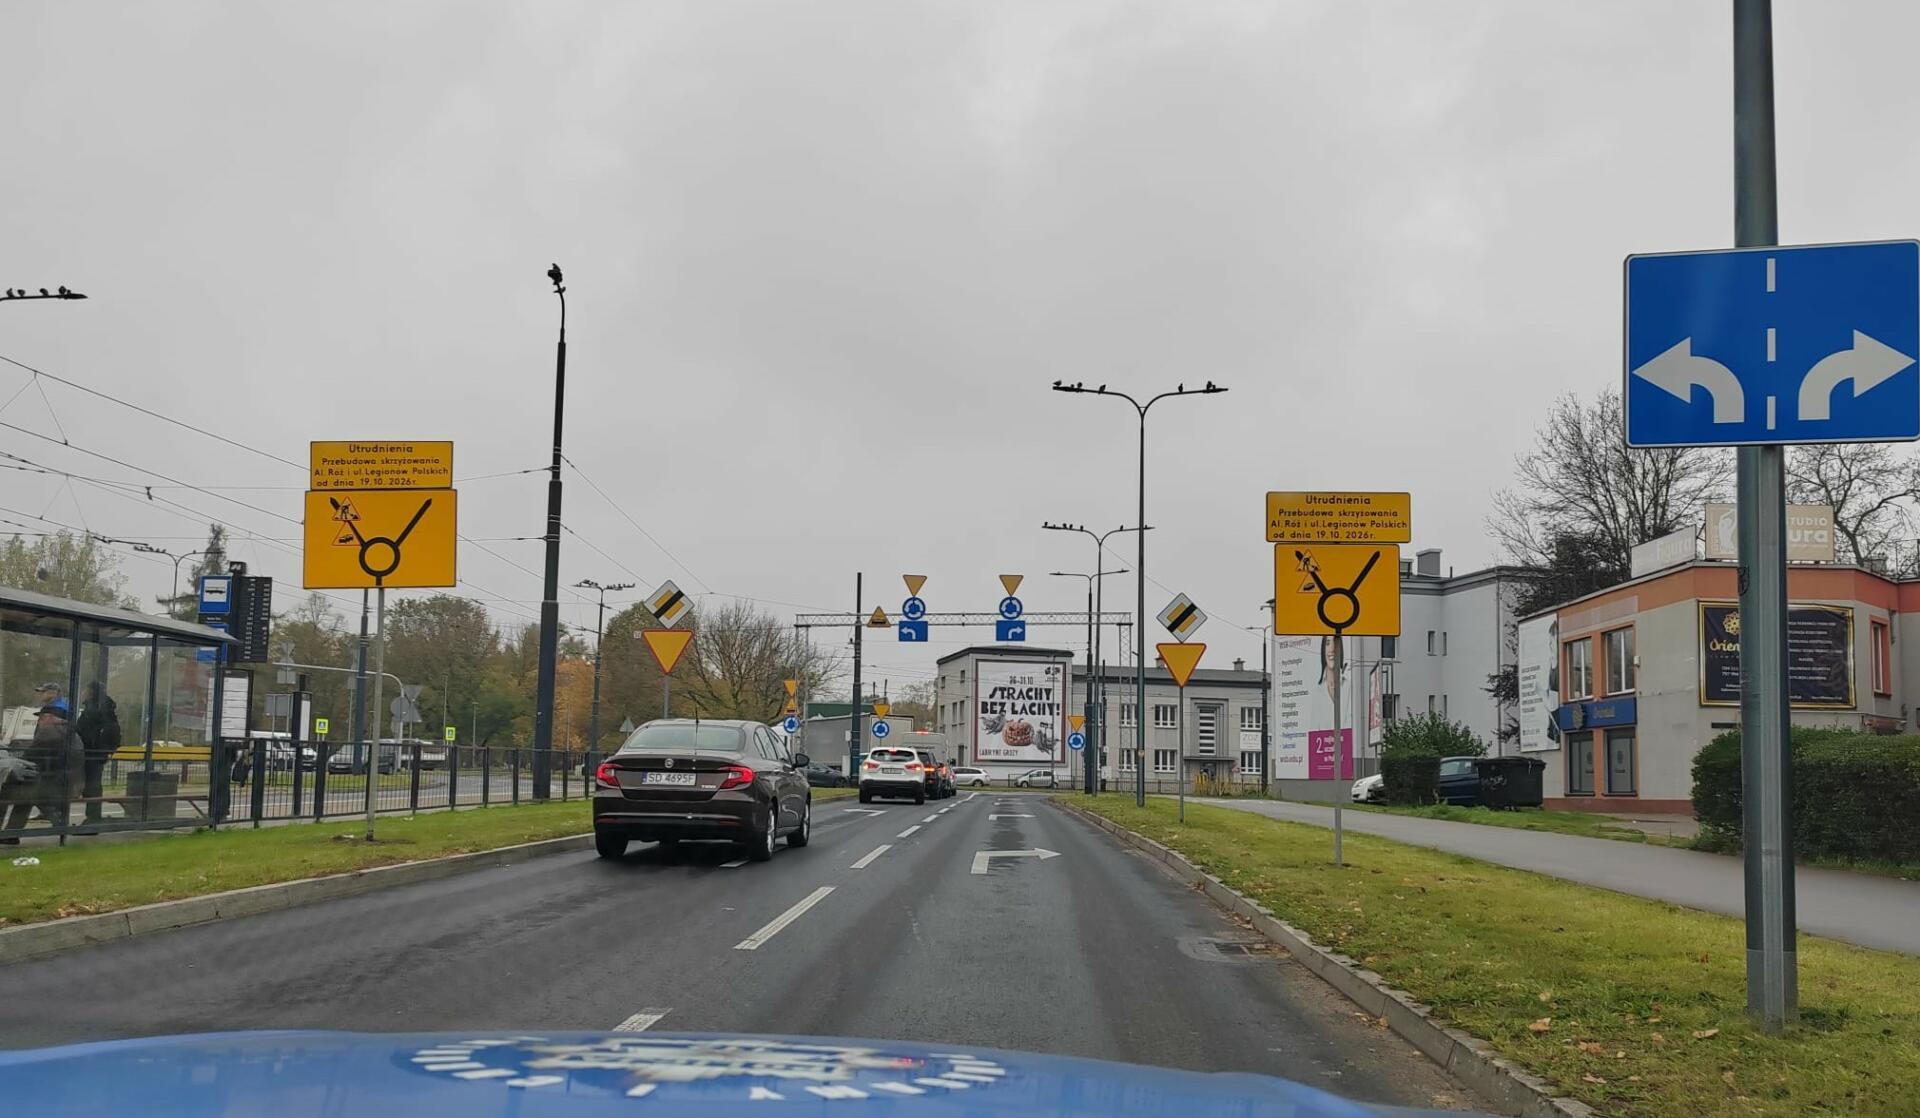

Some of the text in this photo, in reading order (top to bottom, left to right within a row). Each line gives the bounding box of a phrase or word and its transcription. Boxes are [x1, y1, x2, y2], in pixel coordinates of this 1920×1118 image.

[349, 444, 413, 453] Utrudnienia
[322, 457, 376, 465] Przebudowa
[412, 466, 449, 475] Polskich
[316, 479, 328, 487] od
[333, 479, 354, 487] dnia
[1305, 495, 1371, 505] Utrudnienia
[1279, 508, 1398, 519] Przebudowa skrzyżowania
[1370, 519, 1408, 528] Polskich
[1787, 516, 1828, 527] TUDIO
[1273, 530, 1285, 539] od
[1290, 530, 1311, 539] dnia
[1788, 529, 1828, 544] ura
[1709, 637, 1740, 651] Orien
[989, 687, 1053, 701] STRACHY
[981, 701, 1007, 715] BEZ
[1316, 737, 1324, 754] 2
[648, 773, 694, 784] SD 4695F
